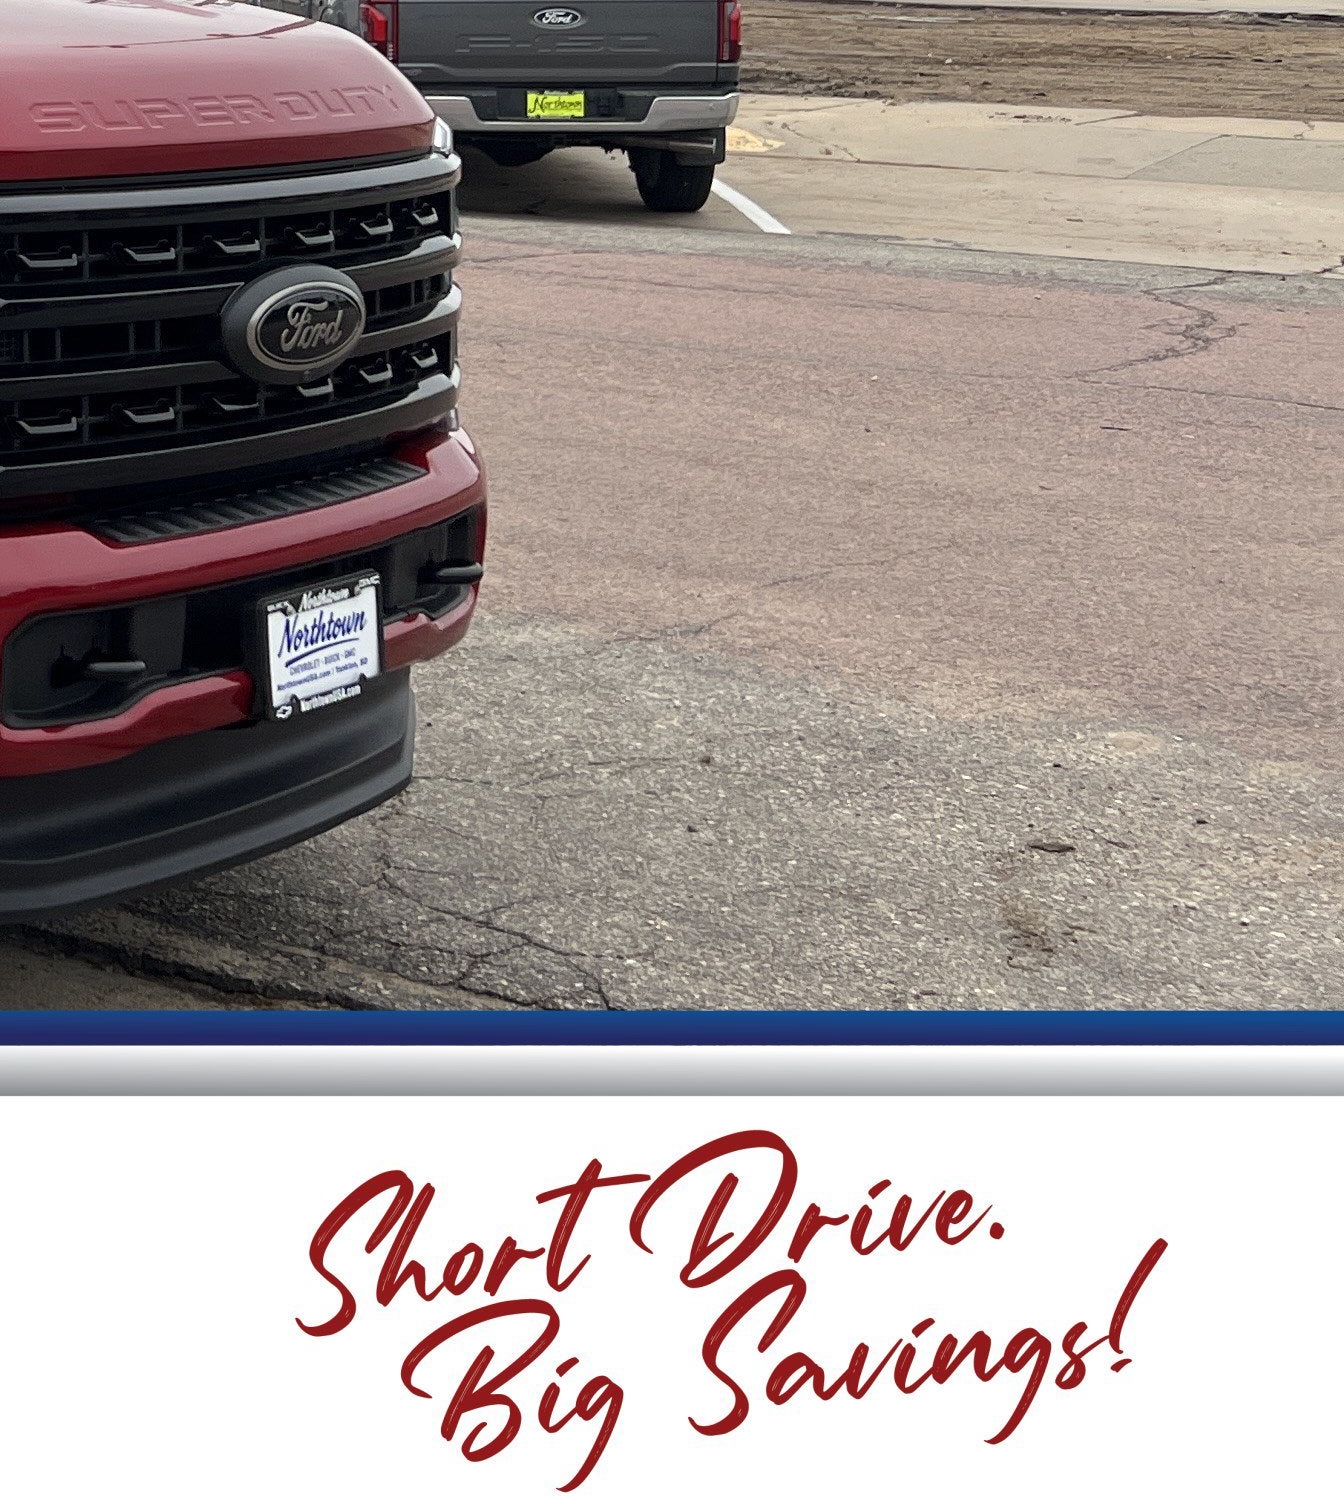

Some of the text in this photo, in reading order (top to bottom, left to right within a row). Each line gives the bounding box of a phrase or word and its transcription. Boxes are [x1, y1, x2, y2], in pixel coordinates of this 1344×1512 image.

[541, 10, 574, 25] Ford
[28, 85, 403, 133] SUPER DUTY
[280, 300, 344, 353] Ford
[277, 609, 366, 658] Northtown
